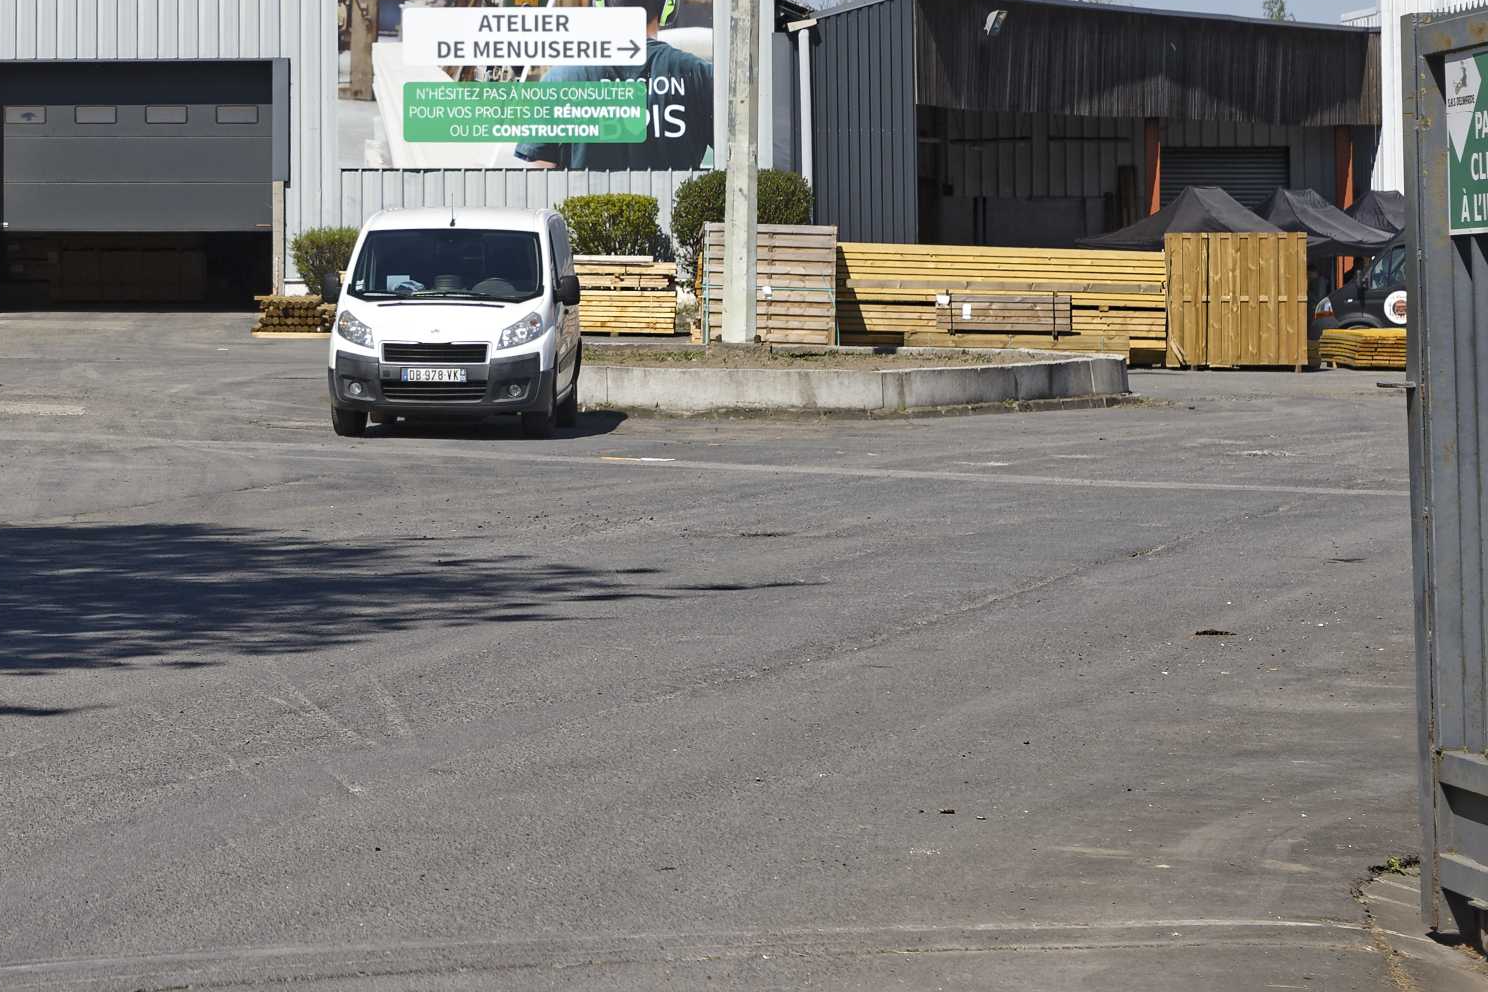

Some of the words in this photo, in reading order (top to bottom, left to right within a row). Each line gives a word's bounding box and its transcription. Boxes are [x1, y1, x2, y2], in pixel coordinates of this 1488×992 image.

[478, 14, 569, 33] ATELIER
[437, 41, 465, 59] DE
[473, 40, 612, 59] MENUISERIE
[416, 85, 480, 101] N'HÉSITEZ
[483, 87, 507, 101] PAS
[509, 85, 519, 100] À
[521, 87, 558, 100] NOUS
[559, 87, 634, 100] CONSULTER
[409, 105, 445, 119] POUR
[446, 105, 473, 119] VOS
[475, 105, 531, 119] PROJETS
[533, 105, 551, 119] DE
[553, 103, 641, 119] RÉNOVATION
[449, 124, 470, 137] OU
[472, 124, 489, 137] DE
[492, 124, 600, 137] CONSTRUCTION
[1461, 186, 1471, 223] À
